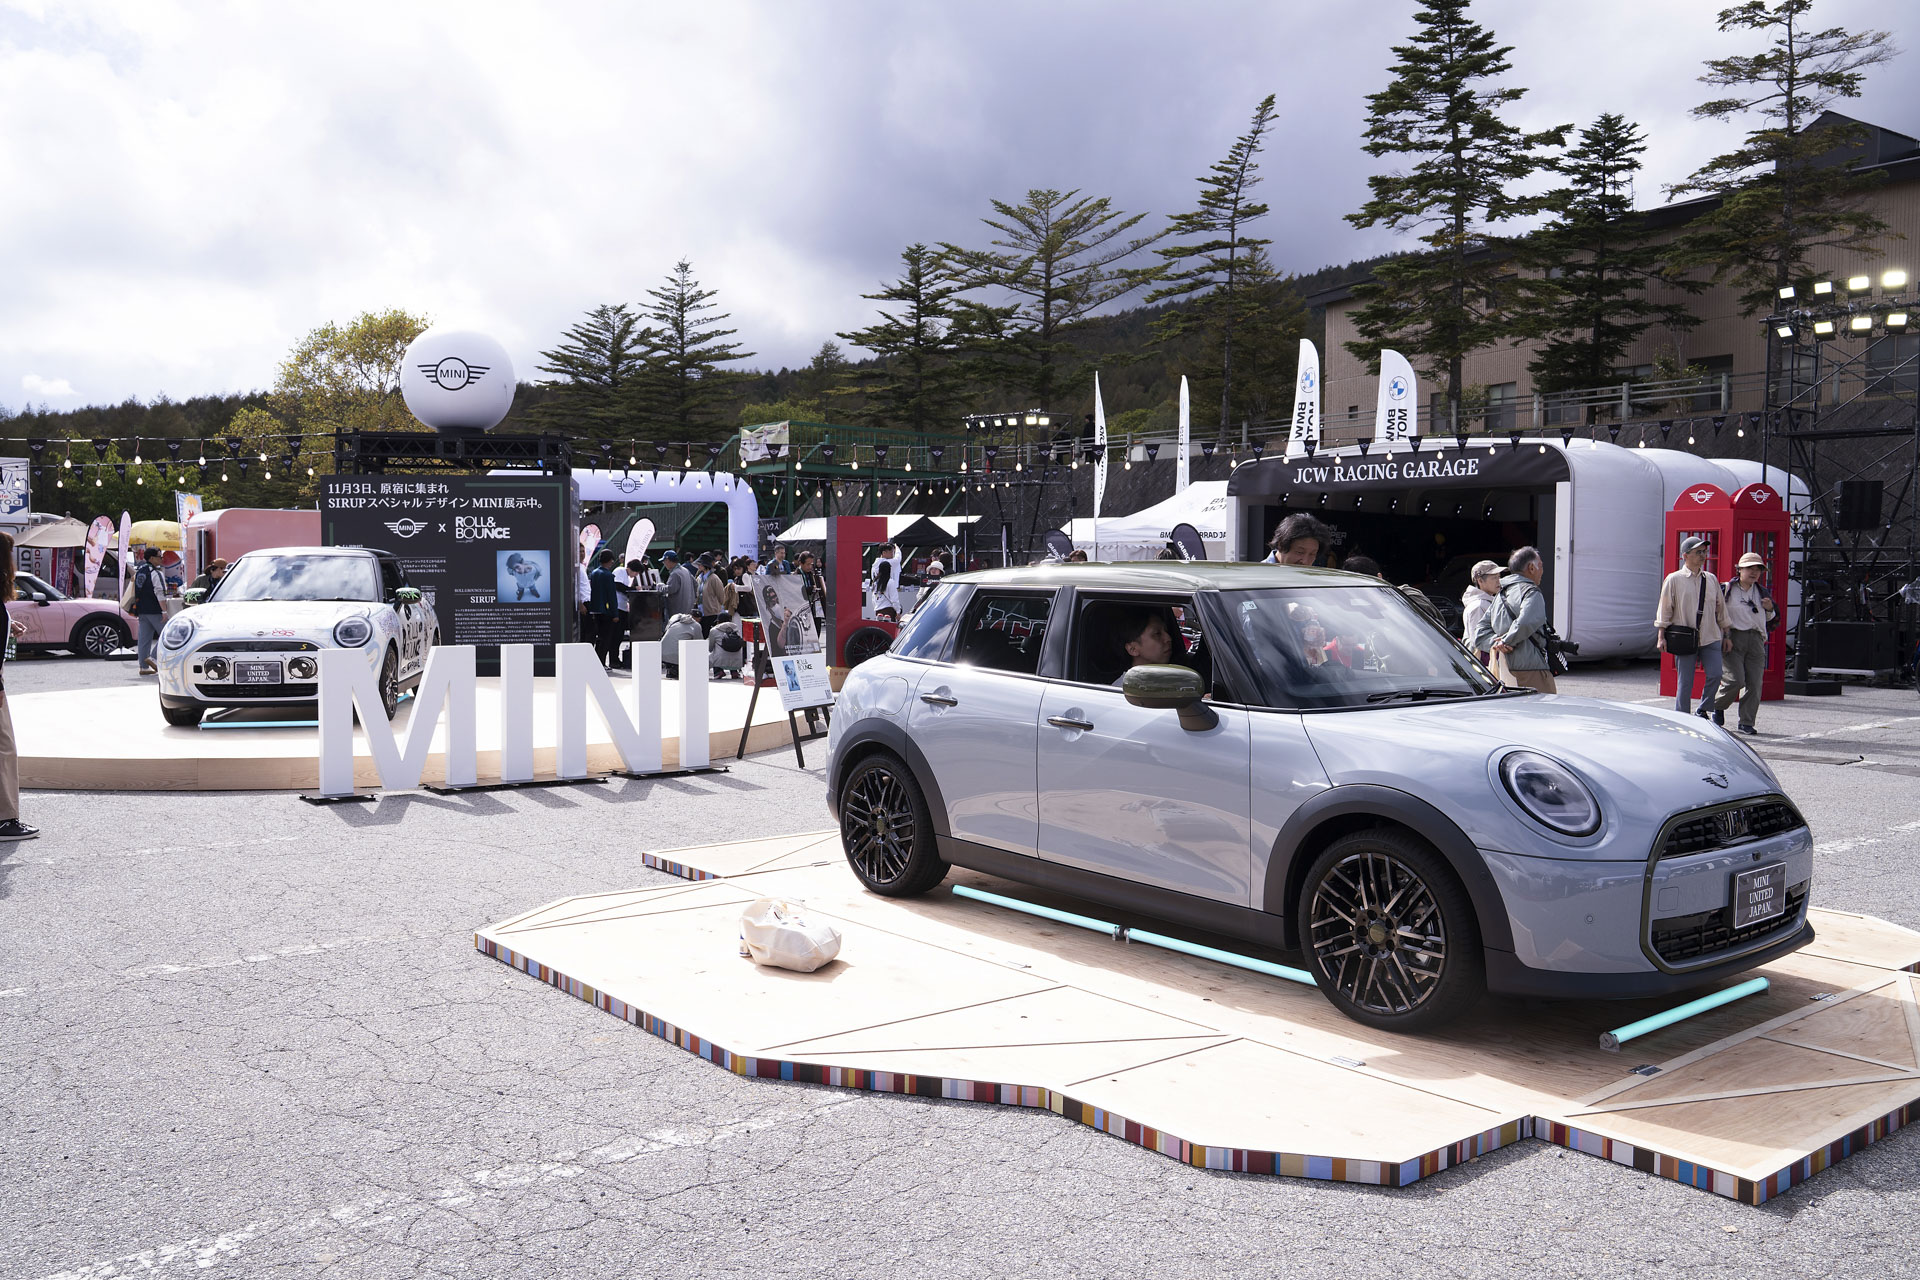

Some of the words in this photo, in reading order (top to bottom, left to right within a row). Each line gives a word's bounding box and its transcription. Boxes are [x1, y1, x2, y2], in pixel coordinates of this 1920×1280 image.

[440, 369, 465, 379] MINI
[1293, 467, 1329, 484] JCW
[1333, 463, 1398, 482] RACING
[1402, 458, 1479, 479] GARAGE
[455, 527, 511, 539] BOUNCE
[470, 595, 496, 603] SIRUP
[318, 638, 710, 797] MINI
[1753, 874, 1770, 890] MINI
[1749, 888, 1774, 904] UNITED
